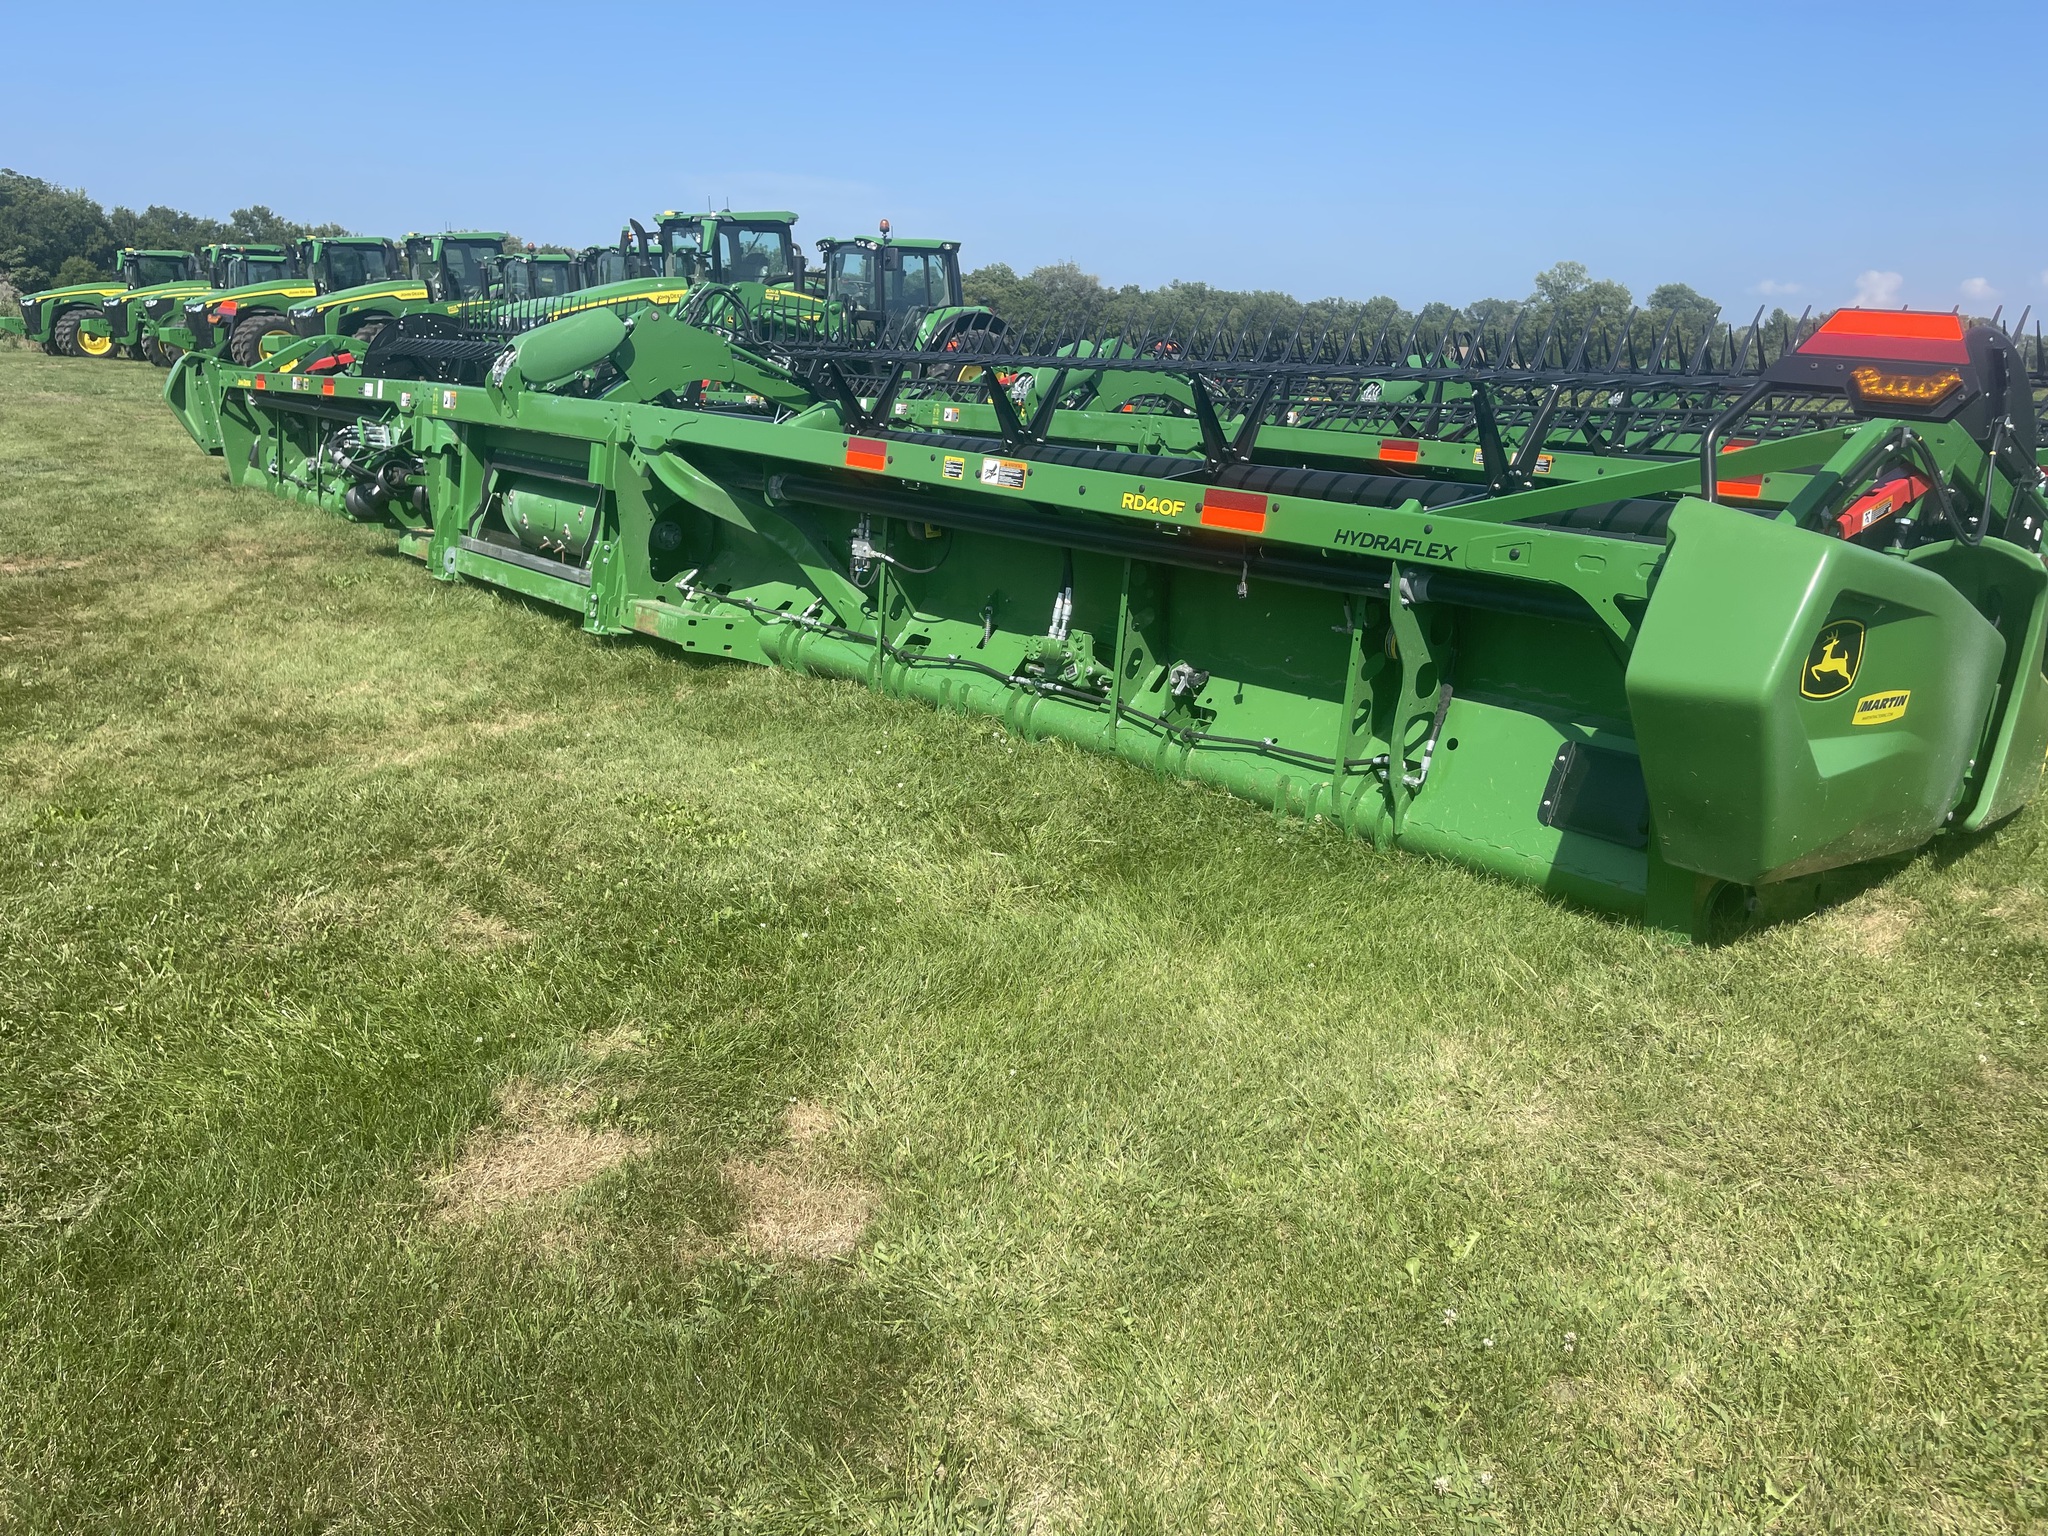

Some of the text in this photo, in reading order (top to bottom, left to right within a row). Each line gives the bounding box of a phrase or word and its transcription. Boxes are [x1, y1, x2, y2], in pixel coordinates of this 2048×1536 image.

[1121, 491, 1186, 517] RD40F
[1333, 528, 1458, 562] HYDRAFLEX
[1858, 694, 1908, 713] MARTIN
